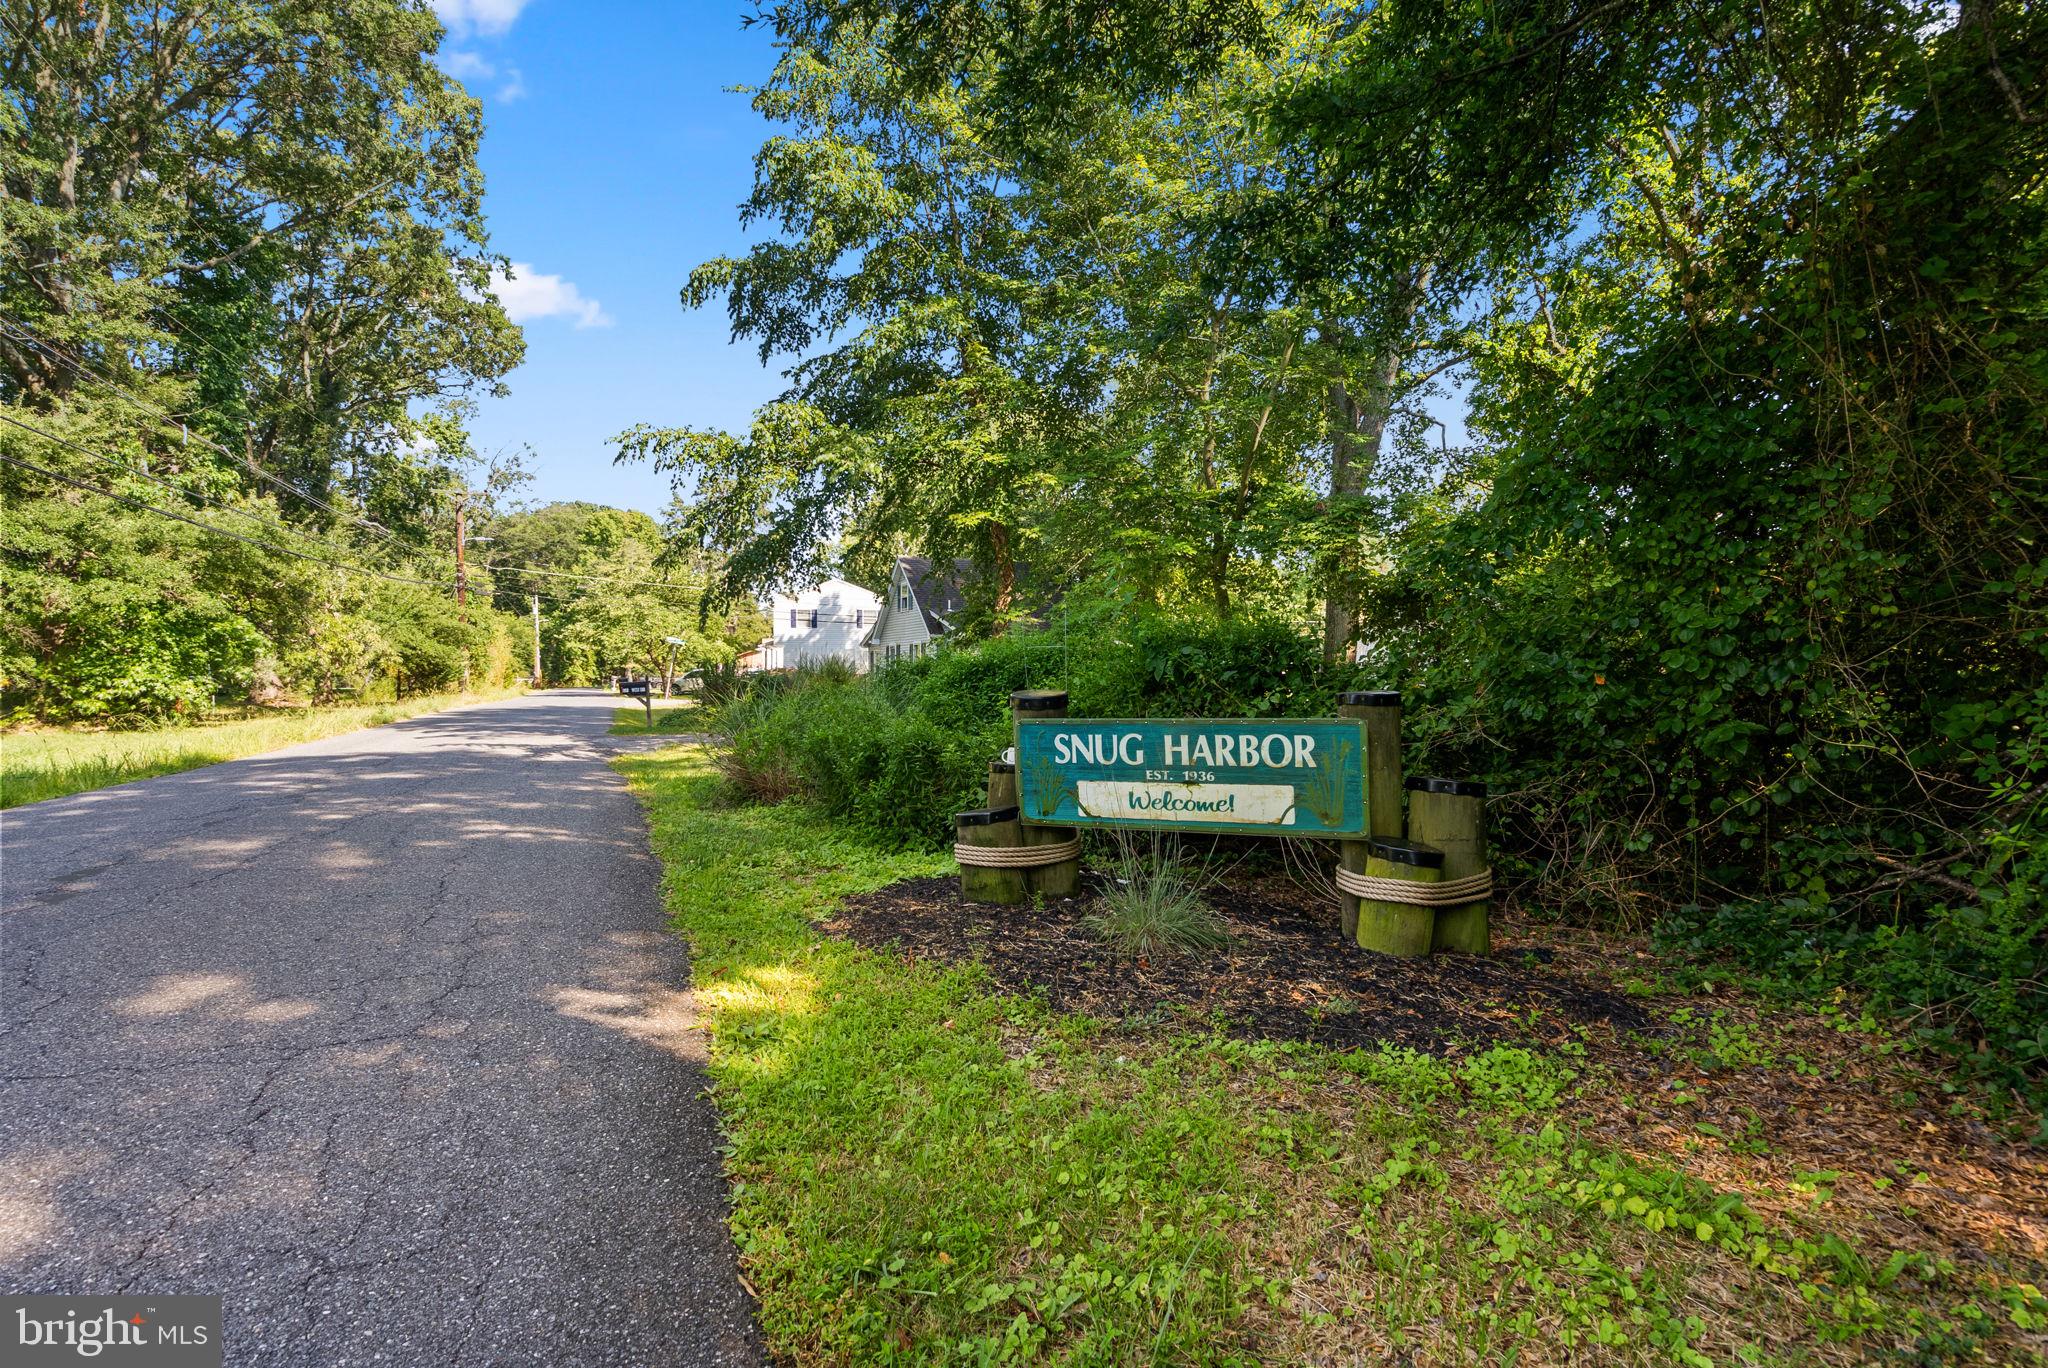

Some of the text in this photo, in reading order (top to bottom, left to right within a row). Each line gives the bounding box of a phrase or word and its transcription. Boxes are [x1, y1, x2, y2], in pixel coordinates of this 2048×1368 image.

[1054, 733, 1317, 768] SNUG HARBOR
[1146, 770, 1215, 782] EST. 1936
[1128, 790, 1235, 813] Welcome!
